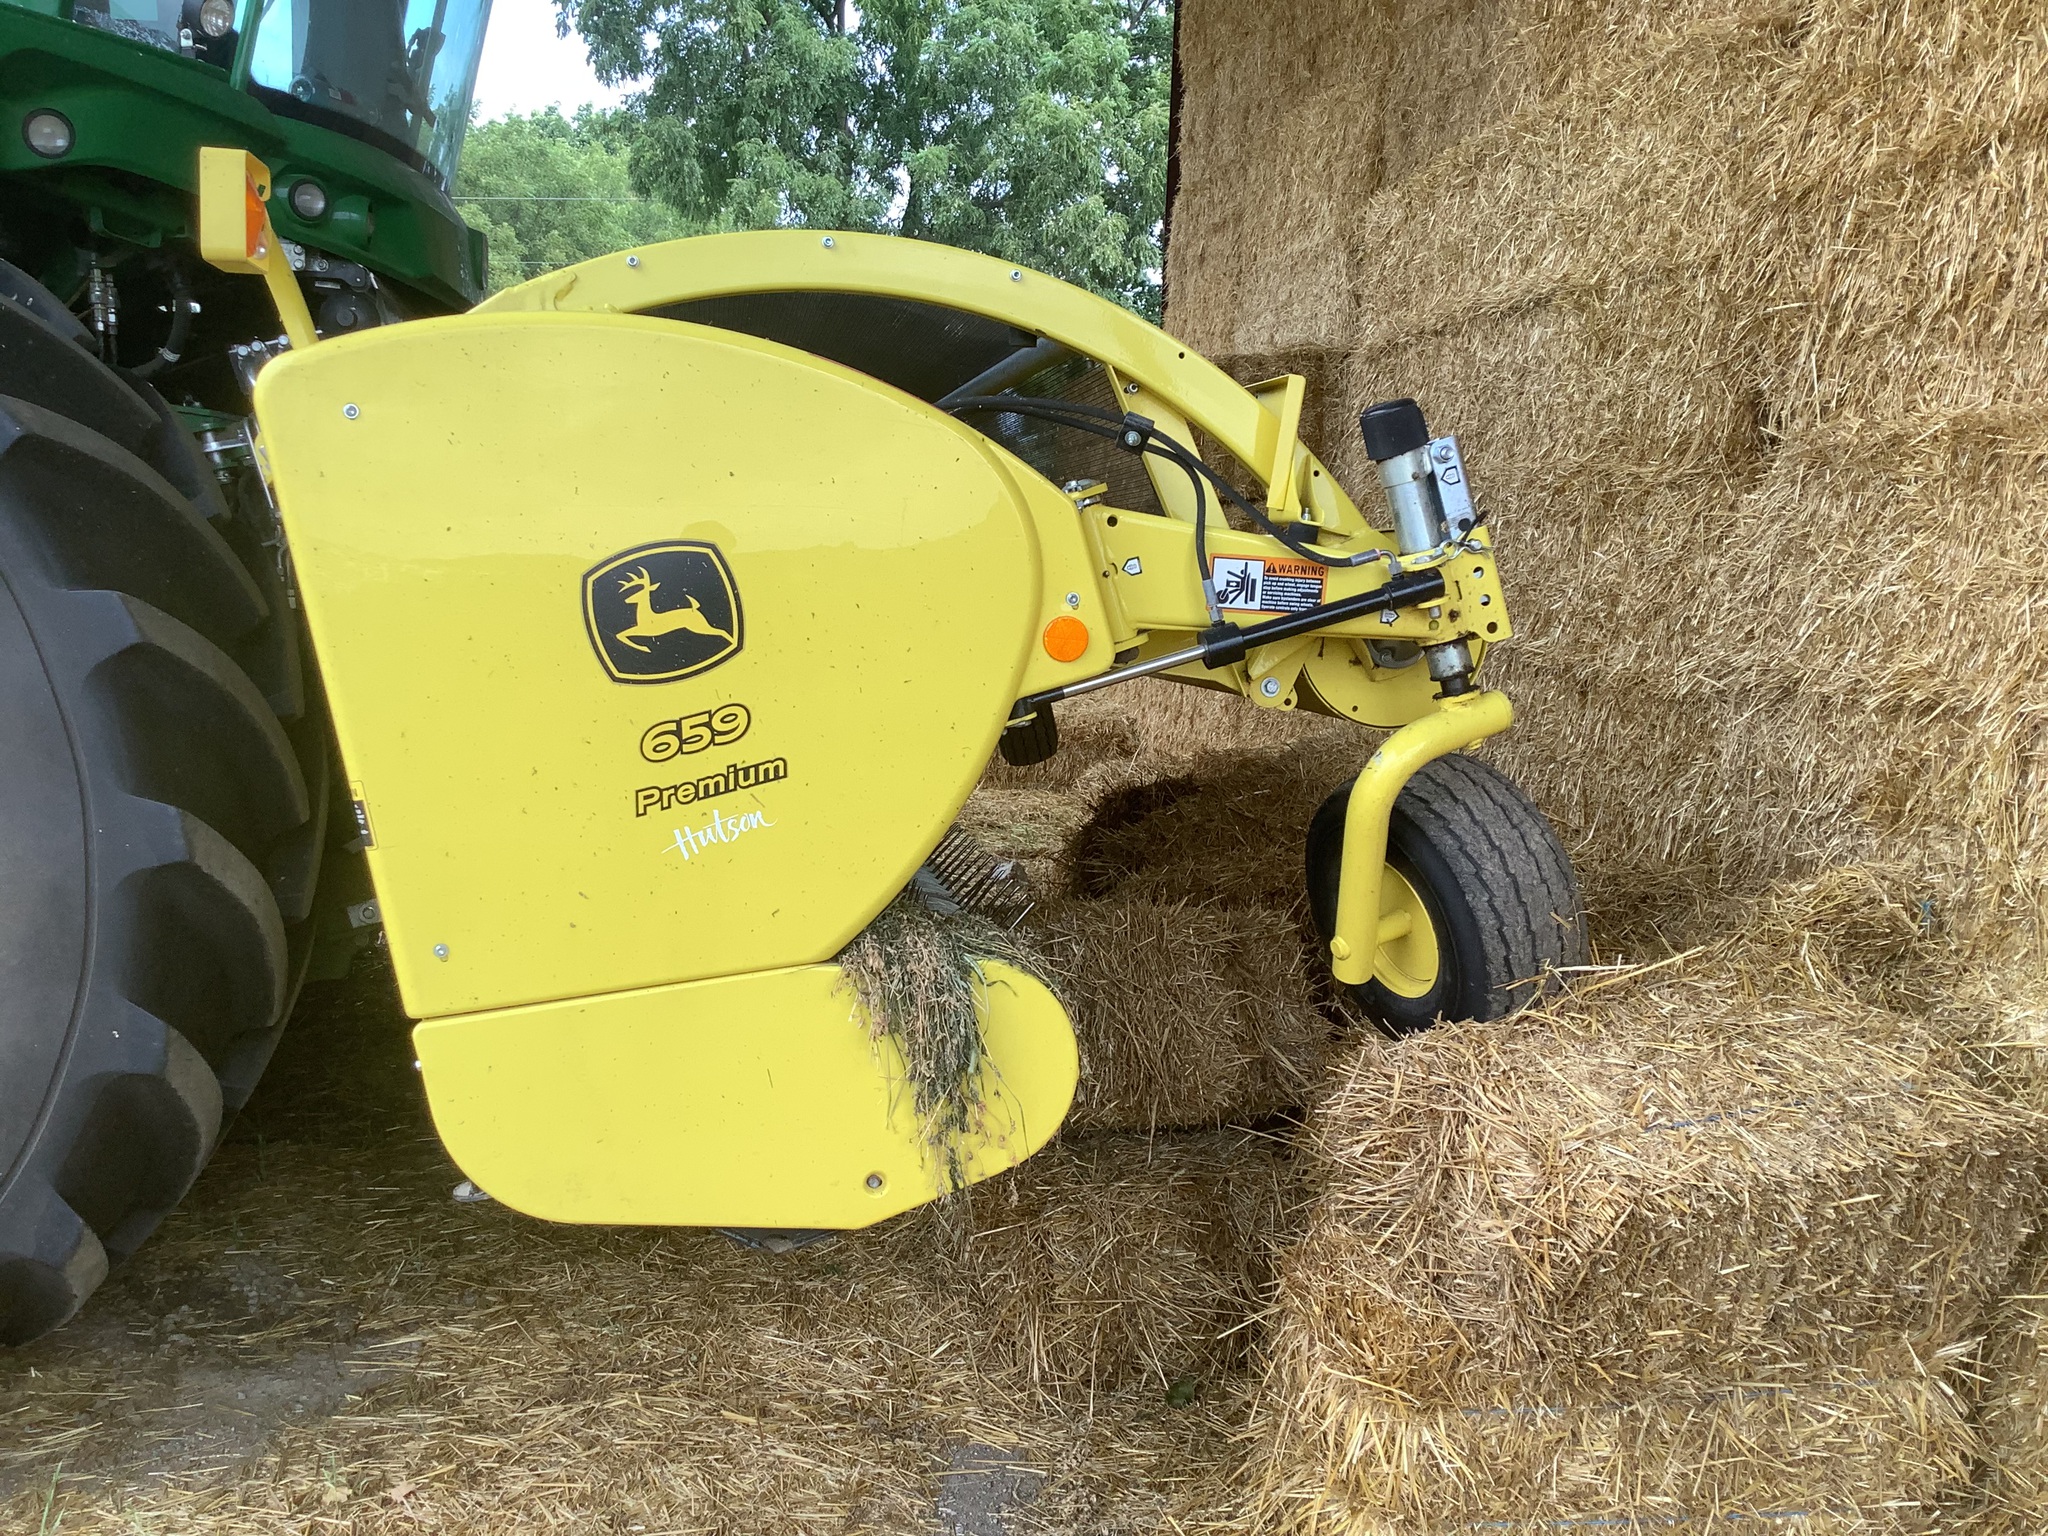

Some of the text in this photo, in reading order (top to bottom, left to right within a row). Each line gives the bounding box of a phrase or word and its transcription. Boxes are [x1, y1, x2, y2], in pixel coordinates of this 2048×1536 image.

[1279, 564, 1324, 576] WARNING
[639, 703, 751, 763] 659
[635, 757, 788, 817] Premium
[661, 809, 777, 861] Hutson
